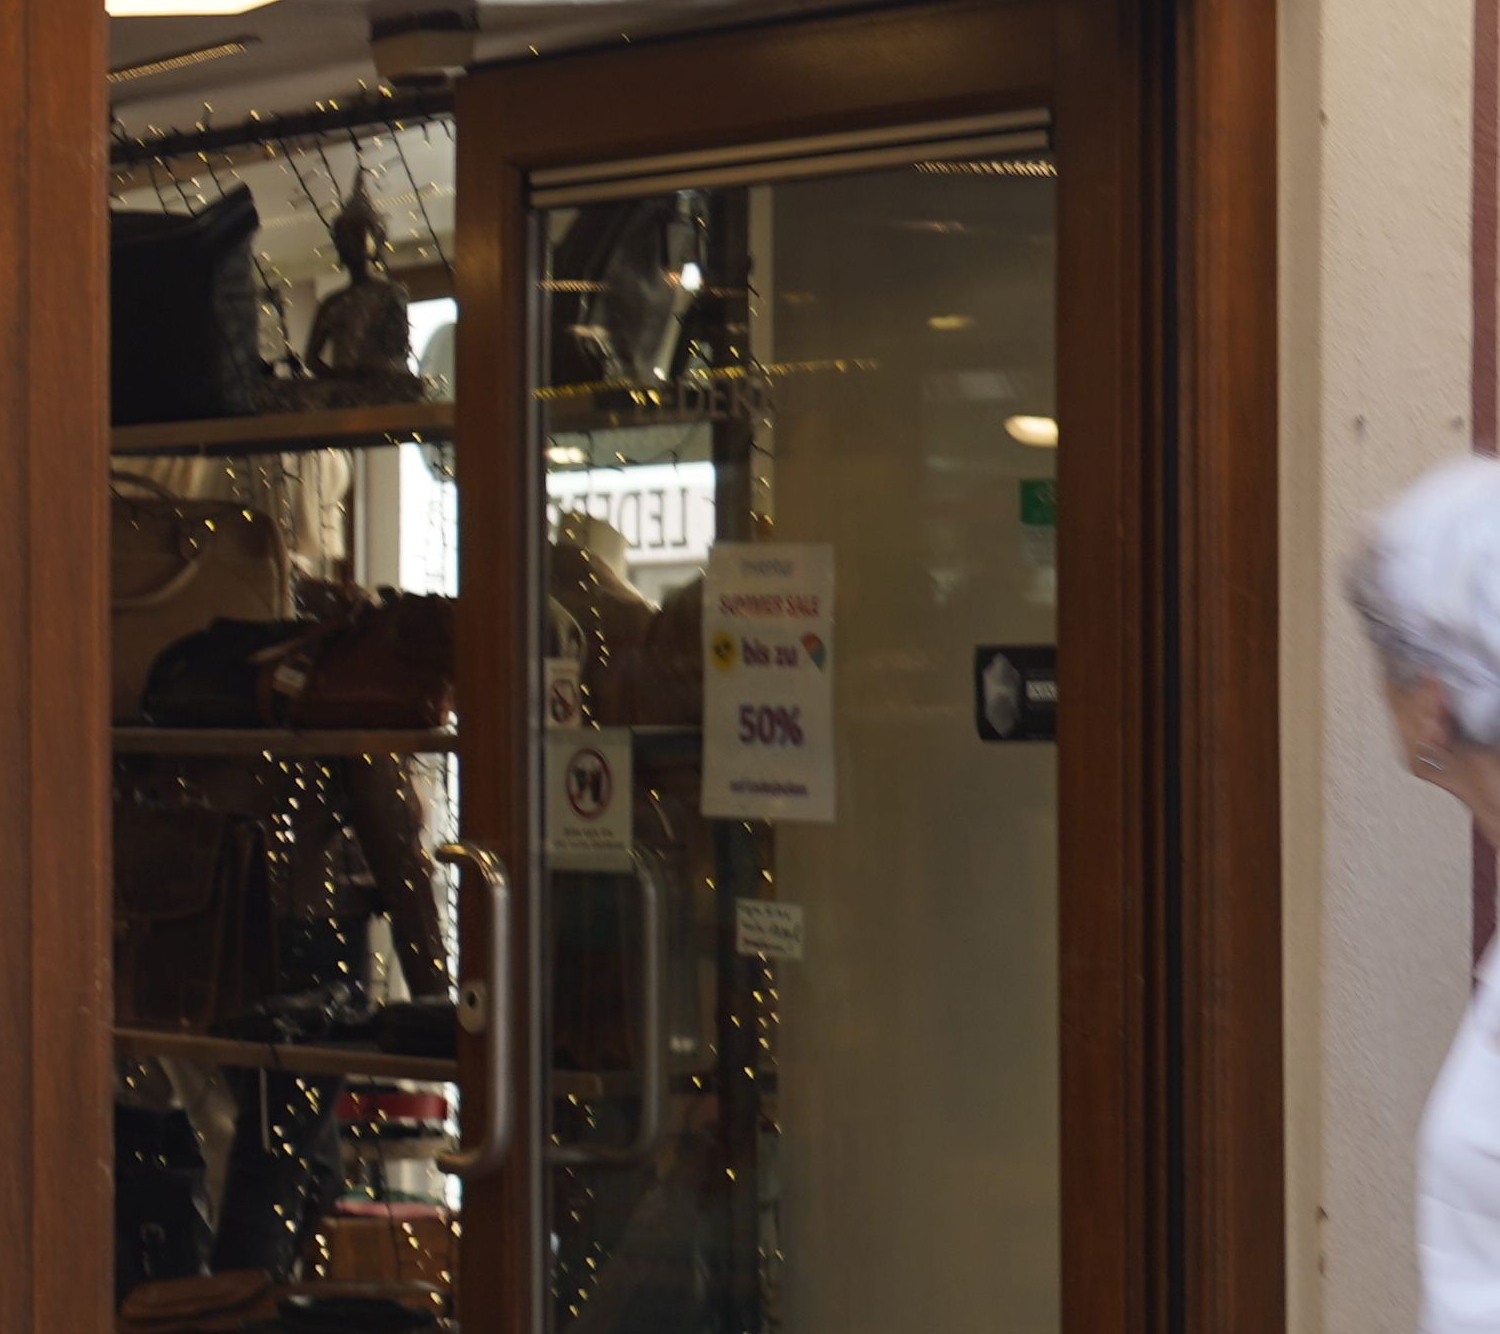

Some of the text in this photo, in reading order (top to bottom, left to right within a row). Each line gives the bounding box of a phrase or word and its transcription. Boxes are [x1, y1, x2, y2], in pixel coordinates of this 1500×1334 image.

[741, 637, 798, 667] bis zu
[738, 705, 804, 747] 50%
